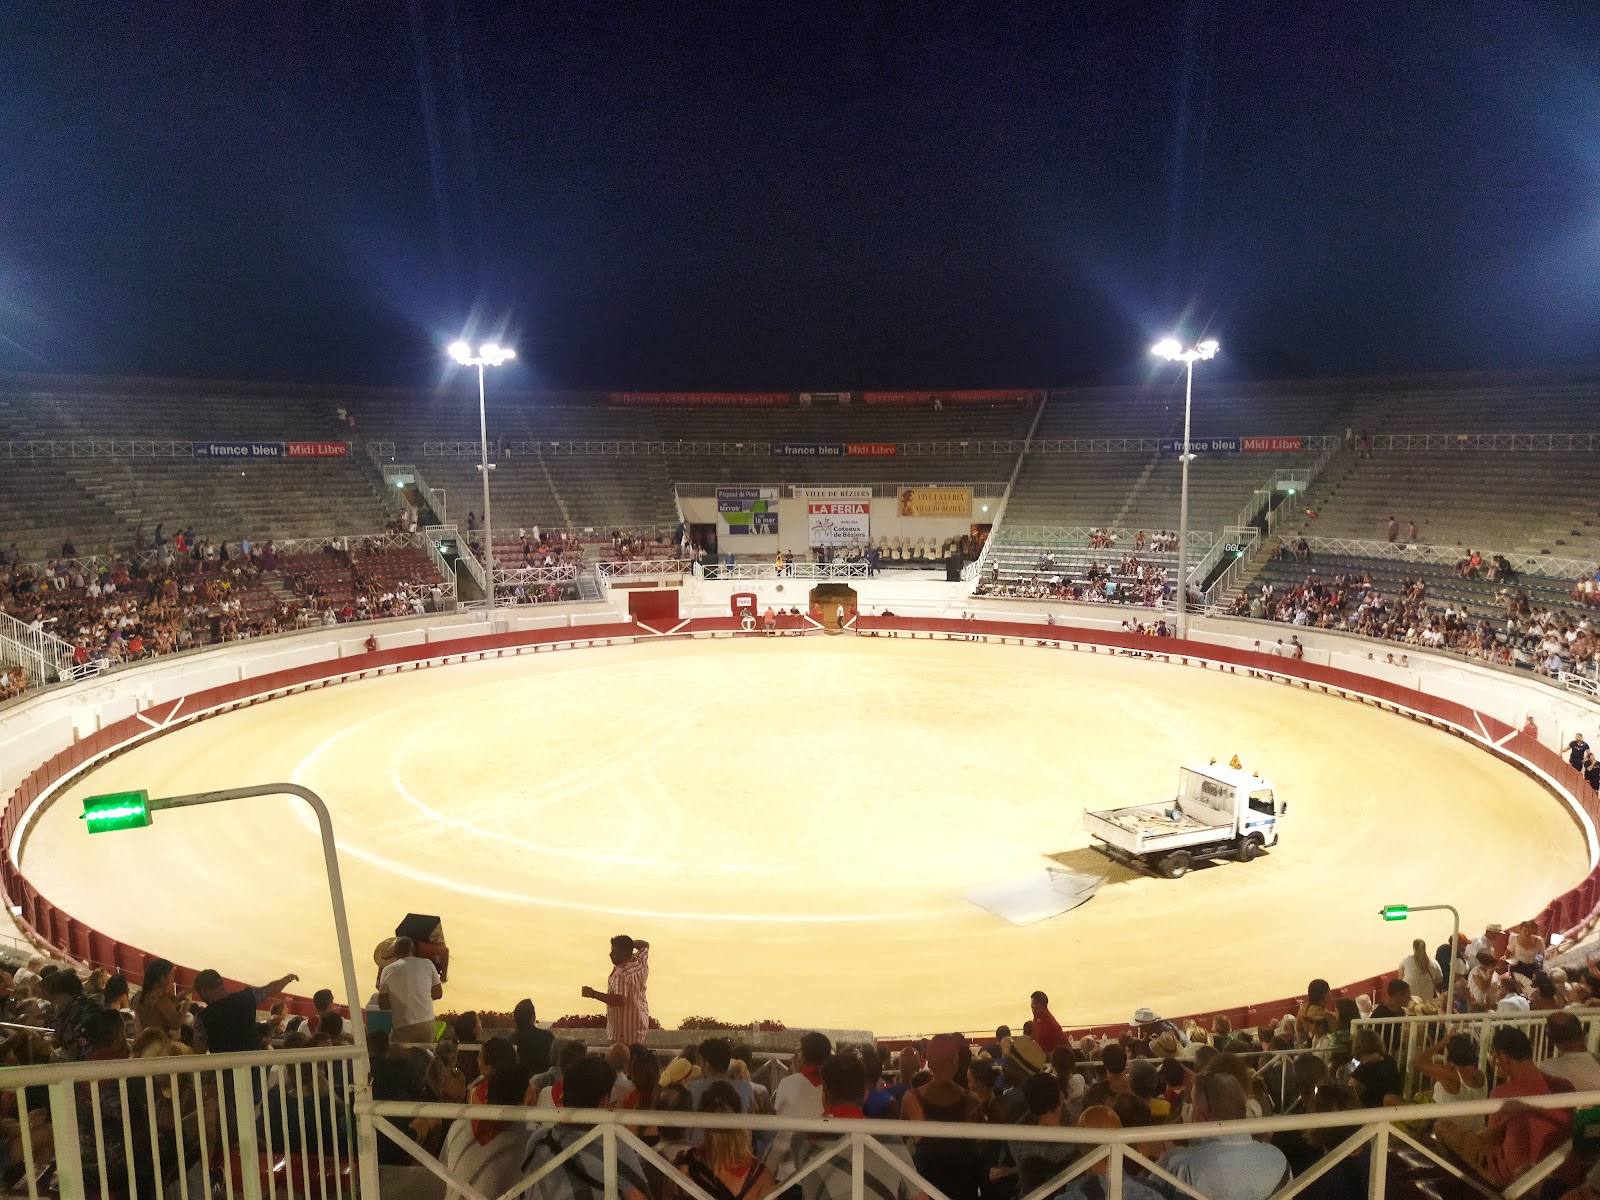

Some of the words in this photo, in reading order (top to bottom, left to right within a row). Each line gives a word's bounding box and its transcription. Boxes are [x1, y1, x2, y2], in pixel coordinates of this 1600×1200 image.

[689, 395, 699, 404] de
[289, 444, 315, 455] Midi
[318, 444, 346, 455] Libre
[1212, 440, 1236, 451] bleu
[1244, 439, 1269, 450] Midi
[1272, 439, 1301, 450] Libre
[210, 444, 249, 456] france
[252, 444, 278, 456] bleu
[784, 445, 816, 455] france
[818, 445, 840, 455] bleu
[847, 445, 869, 455] Midi
[871, 445, 895, 455] Libre
[917, 493, 932, 501] VIVE
[934, 493, 943, 501] LA
[944, 493, 964, 501] FERIA
[812, 504, 828, 514] LA
[831, 504, 864, 514] FERIA
[1225, 543, 1241, 552] GGL
